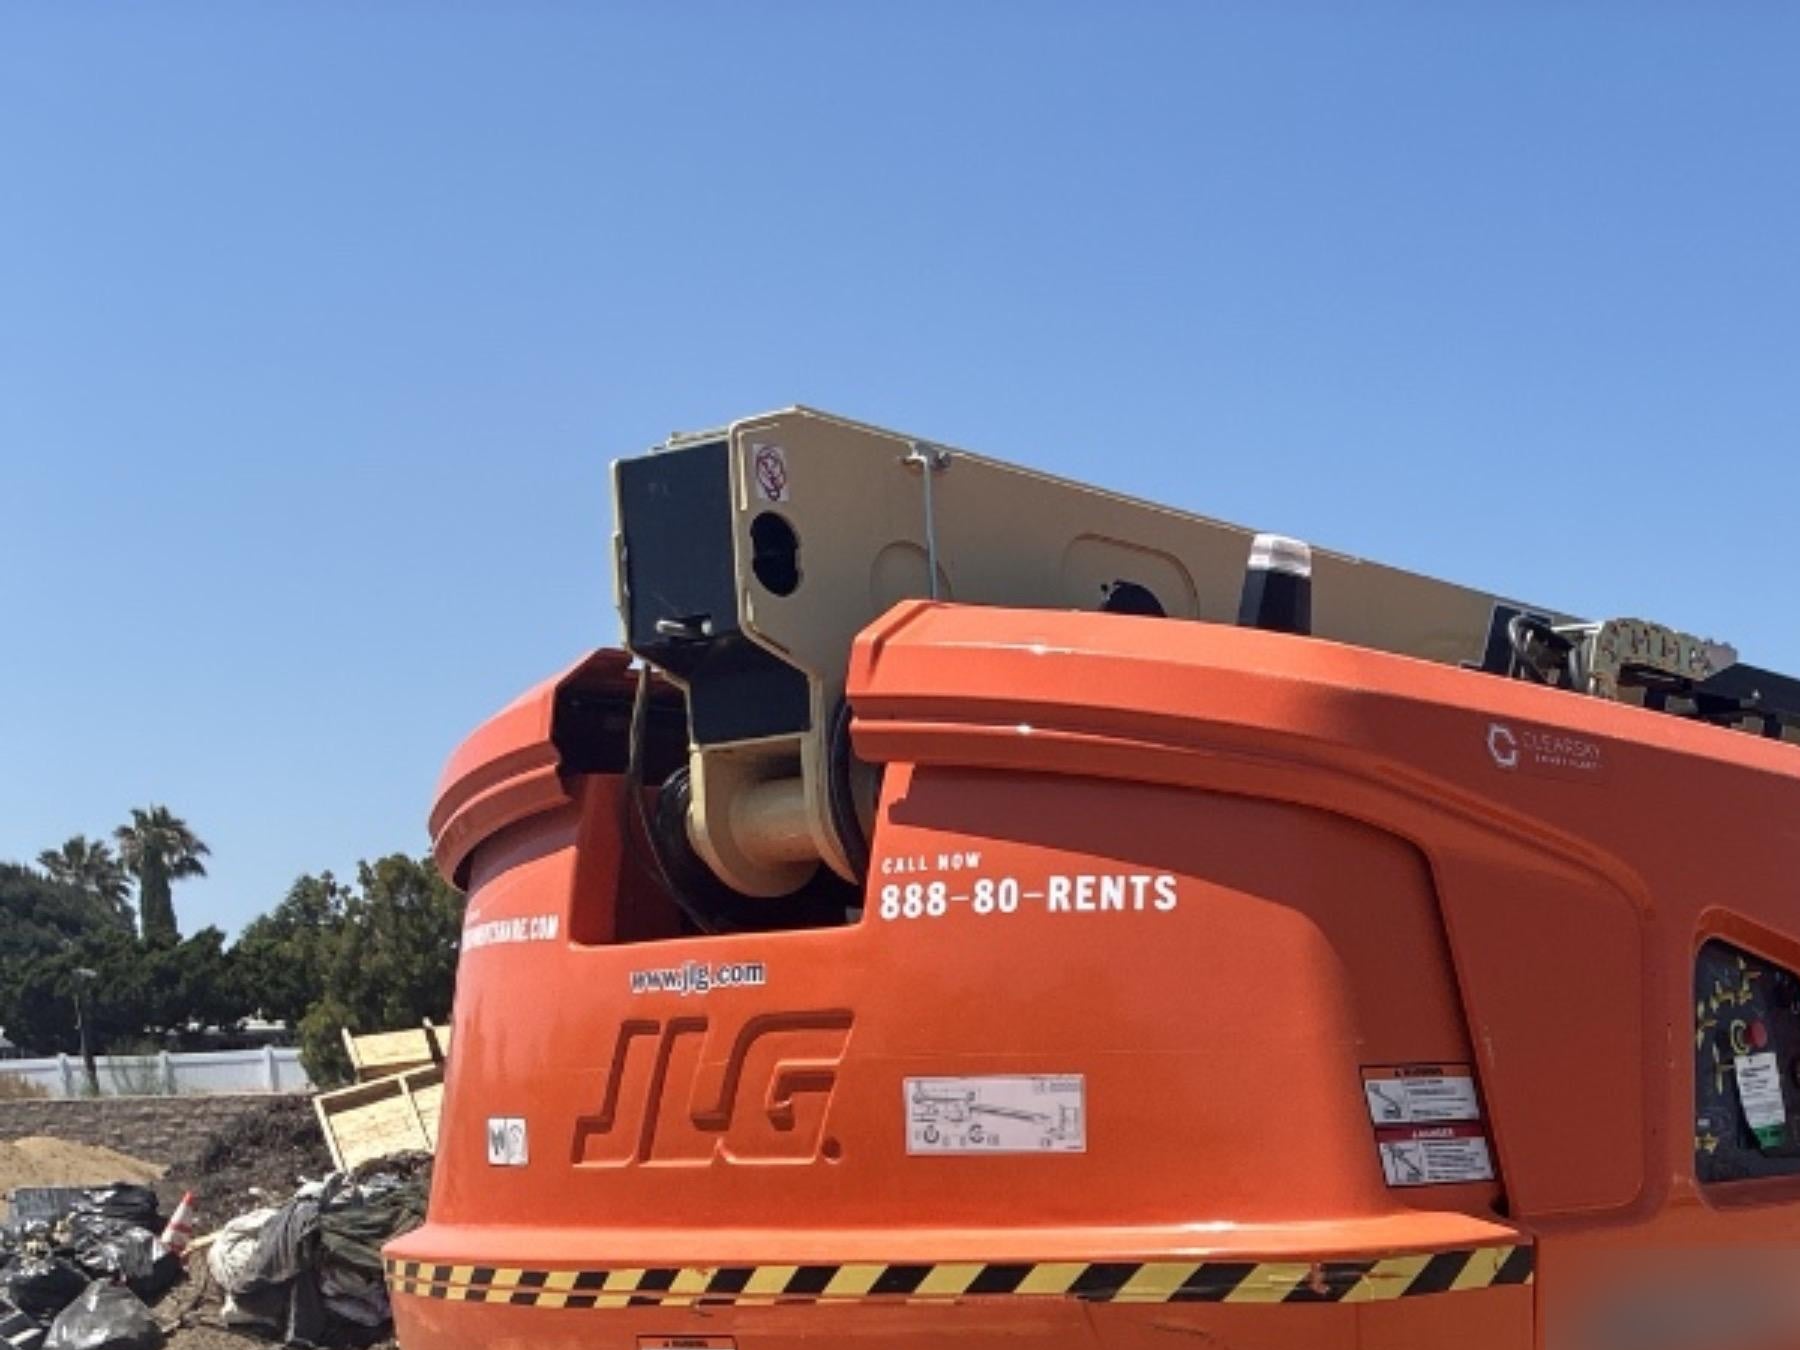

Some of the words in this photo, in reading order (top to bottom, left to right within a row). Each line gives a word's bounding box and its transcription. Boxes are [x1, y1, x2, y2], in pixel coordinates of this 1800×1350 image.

[881, 855, 929, 875] CALL
[937, 851, 982, 870] NOW
[879, 874, 1179, 920] 888-80-RENTS
[630, 961, 767, 996] www.jlg.com
